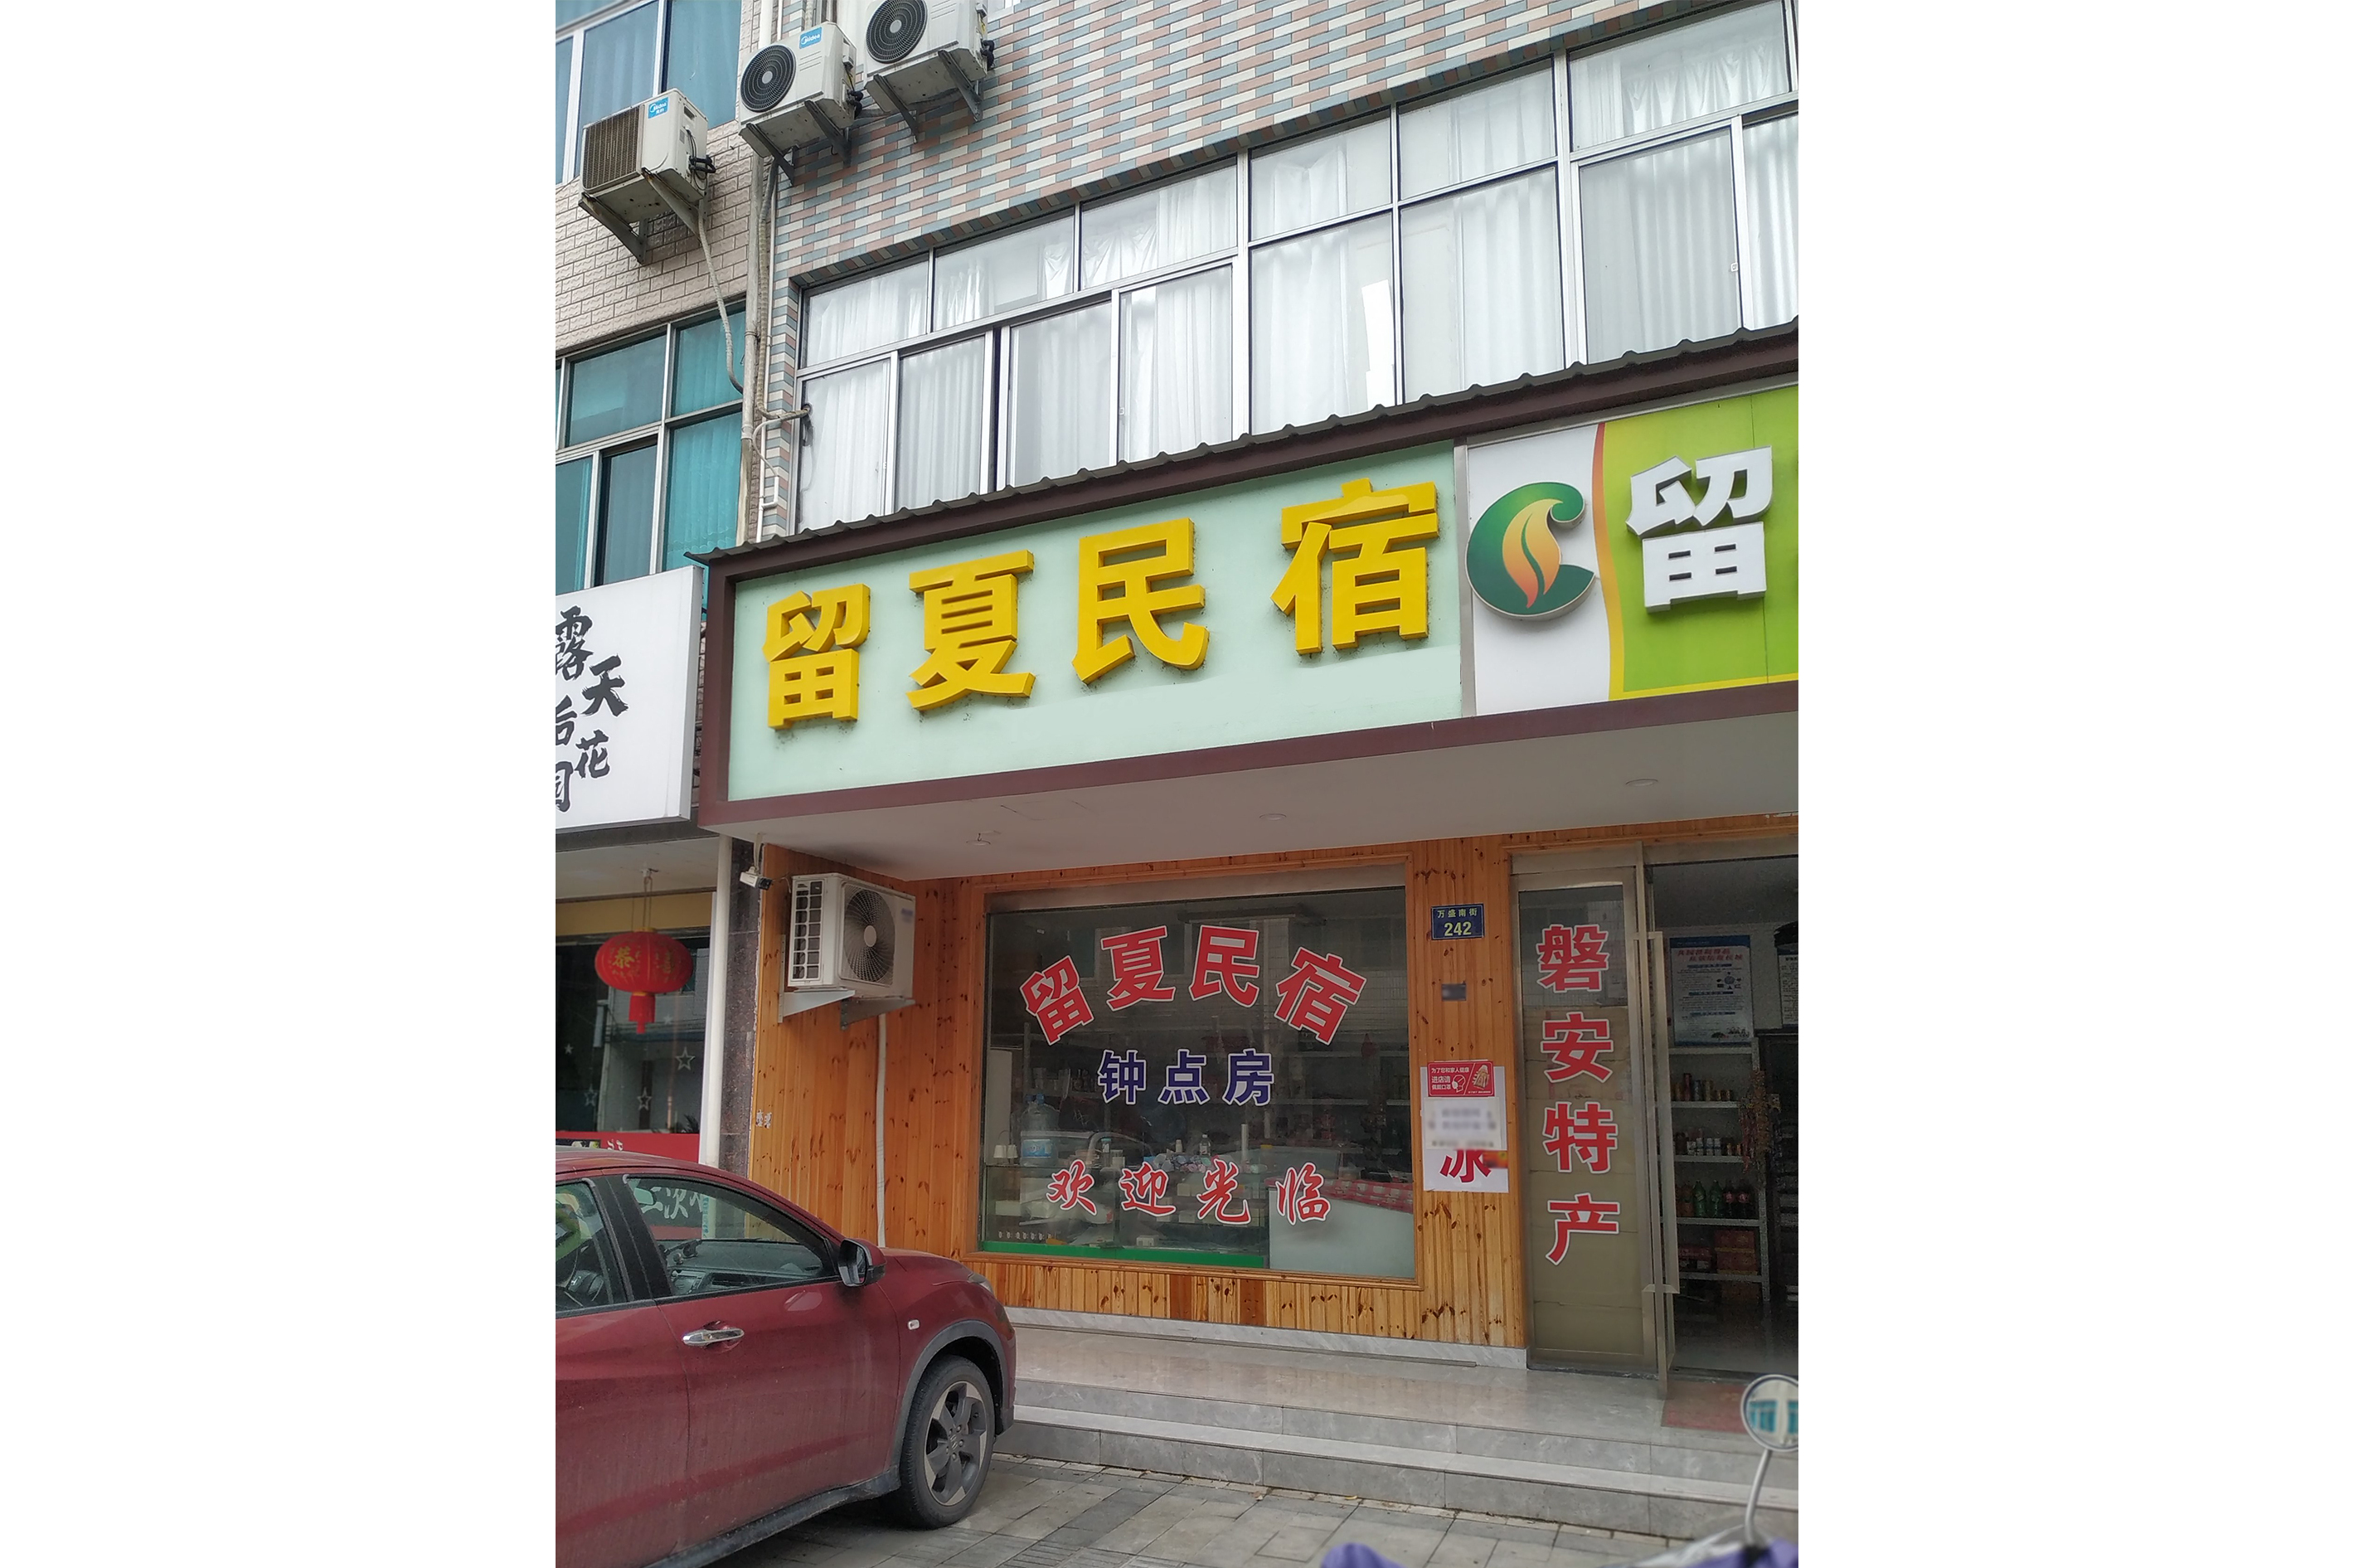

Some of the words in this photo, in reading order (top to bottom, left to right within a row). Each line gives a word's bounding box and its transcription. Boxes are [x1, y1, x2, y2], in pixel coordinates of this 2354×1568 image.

[1625, 445, 1773, 614] 留
[762, 478, 1439, 730] 留夏民宿
[1437, 907, 1478, 919] 万盛南街
[1444, 921, 1472, 936] 242
[1019, 925, 1367, 1046] 留夏民宿
[1098, 1048, 1274, 1106] 钟点房
[1536, 925, 1620, 1265] 磐安特产
[1046, 1159, 1331, 1225] 欢迎光临
